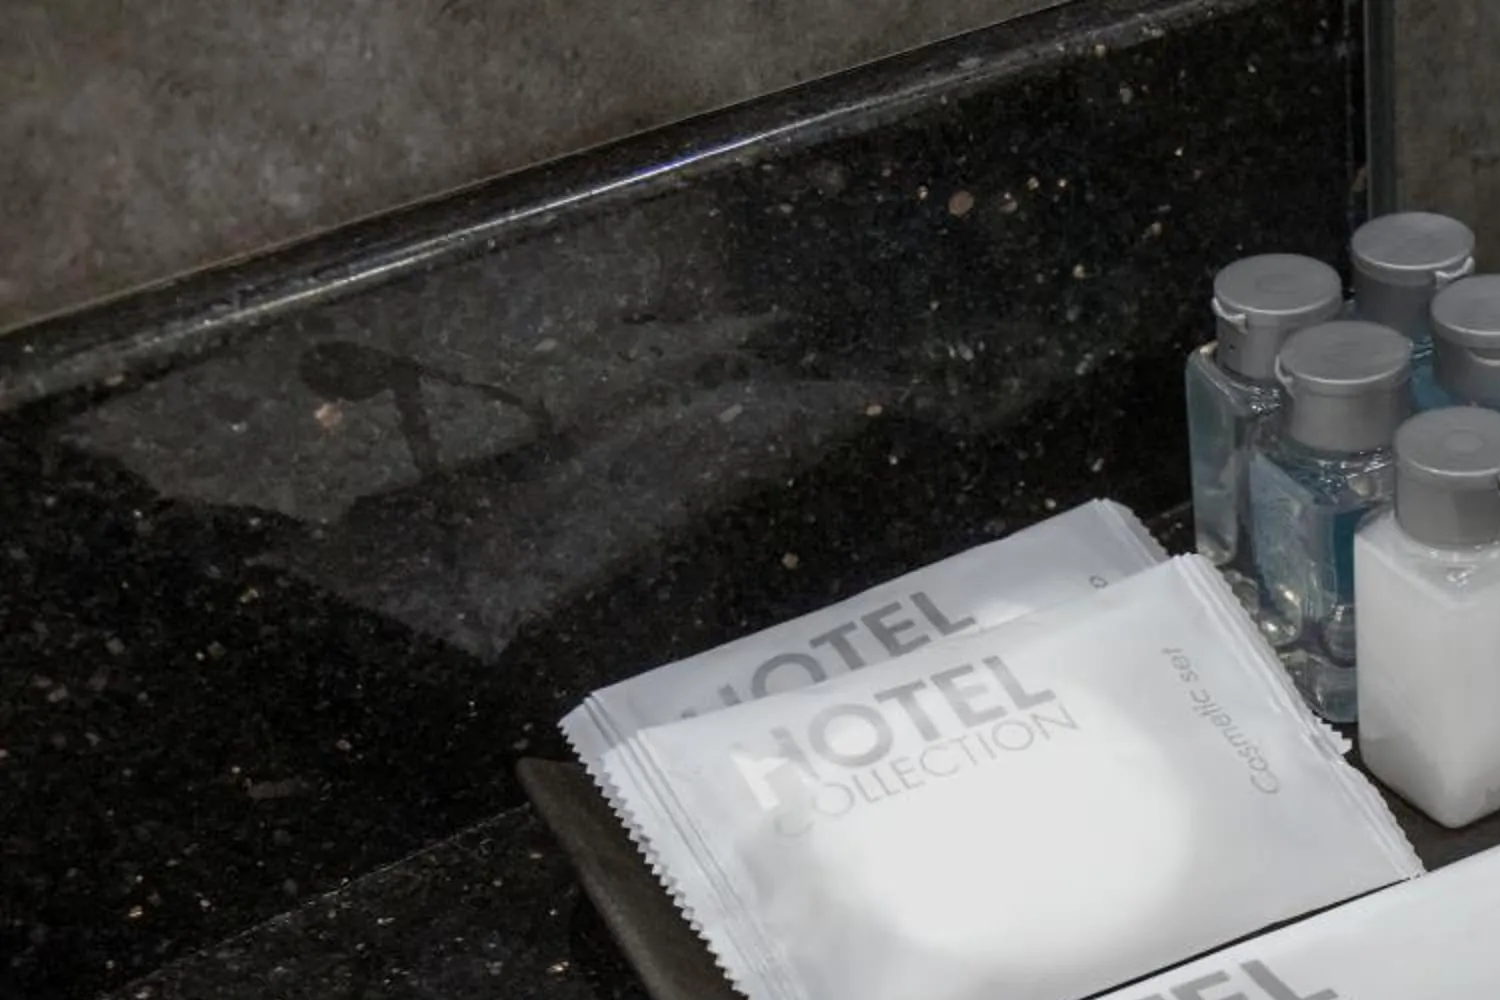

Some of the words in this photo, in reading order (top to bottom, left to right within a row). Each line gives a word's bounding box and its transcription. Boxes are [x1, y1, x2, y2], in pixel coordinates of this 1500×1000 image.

[681, 591, 976, 719] OTEL
[1160, 648, 1199, 683] set
[729, 655, 1057, 812] HOTEL
[774, 704, 1079, 838] COLLECTION
[1190, 690, 1280, 795] Cosmetic
